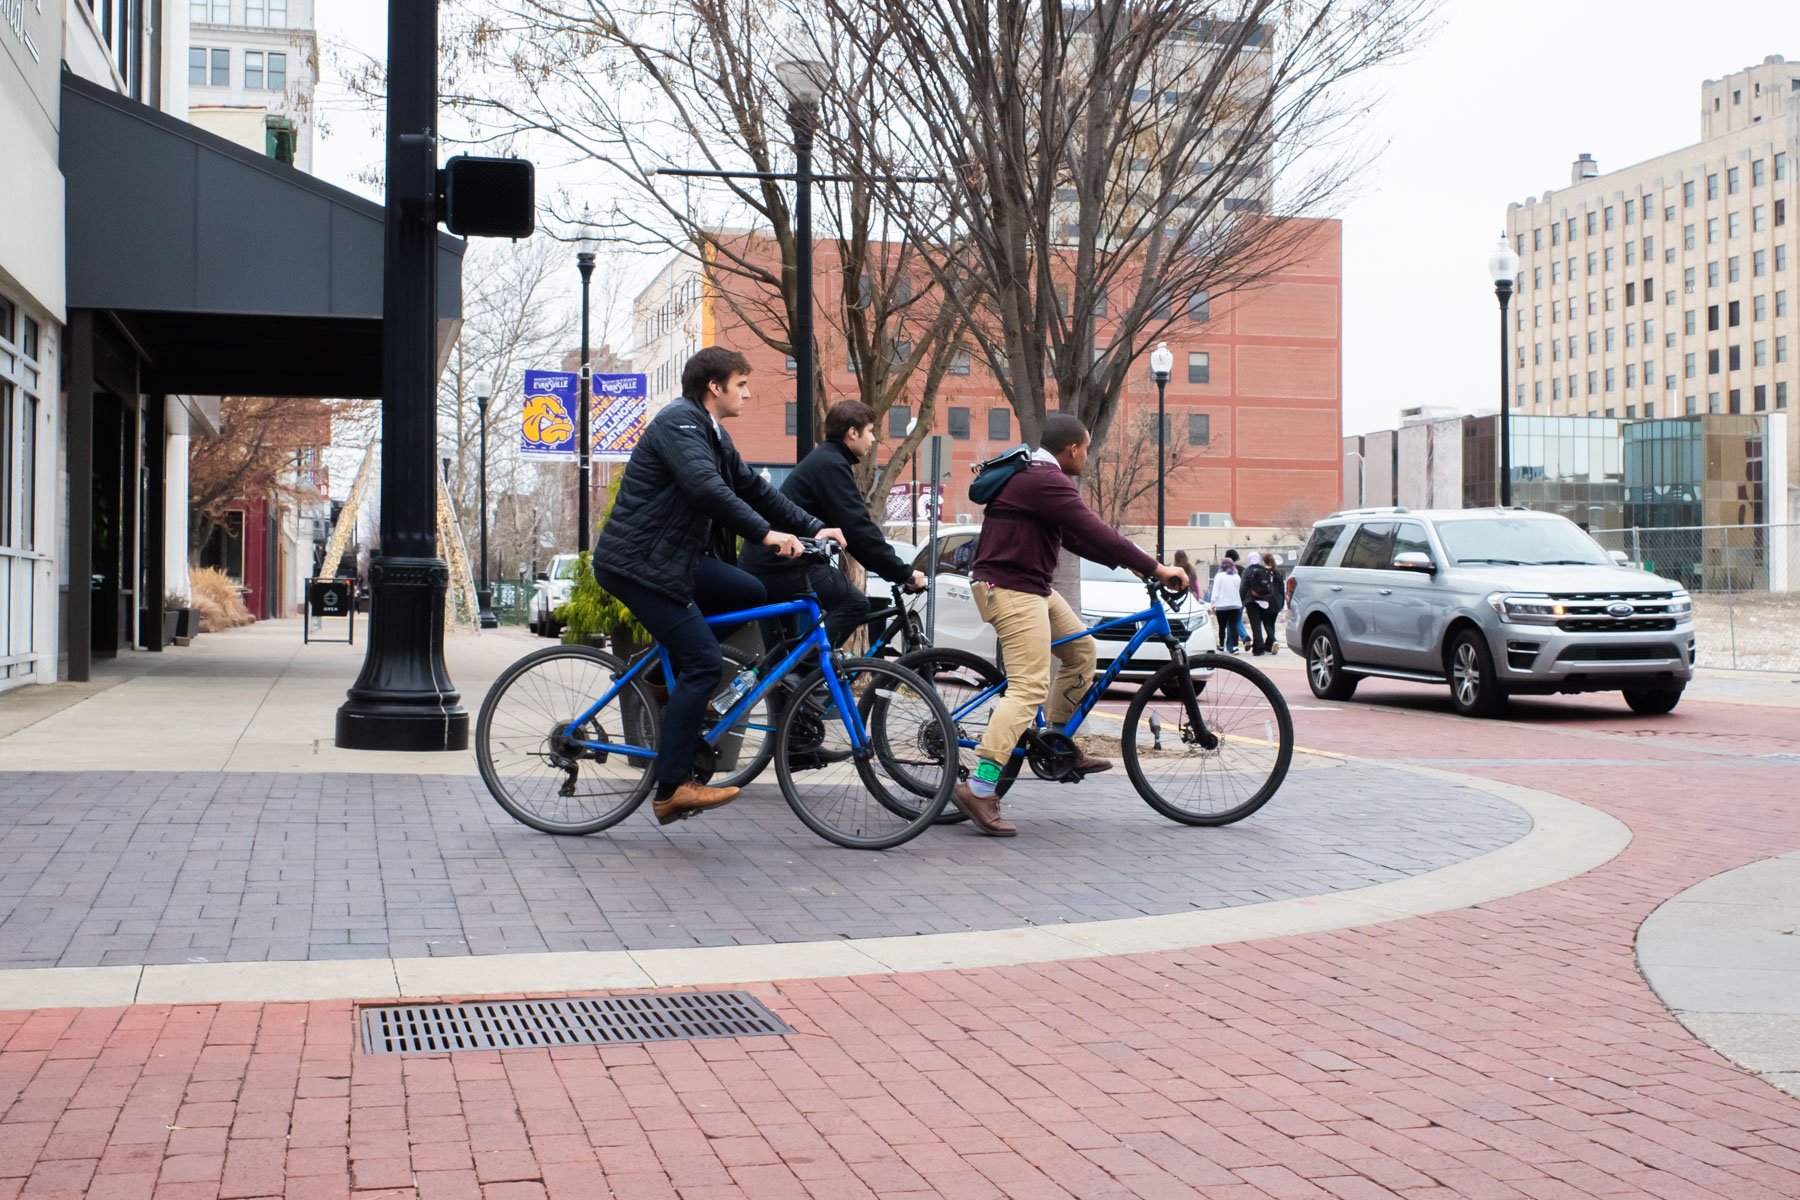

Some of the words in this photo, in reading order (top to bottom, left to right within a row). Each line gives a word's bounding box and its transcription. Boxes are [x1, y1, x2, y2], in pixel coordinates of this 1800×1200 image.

[533, 379, 569, 392] EVANSVILLE
[602, 382, 638, 394] EVANSVILLE
[592, 396, 629, 433] WESTERN
[600, 399, 637, 435] ILLINOIS
